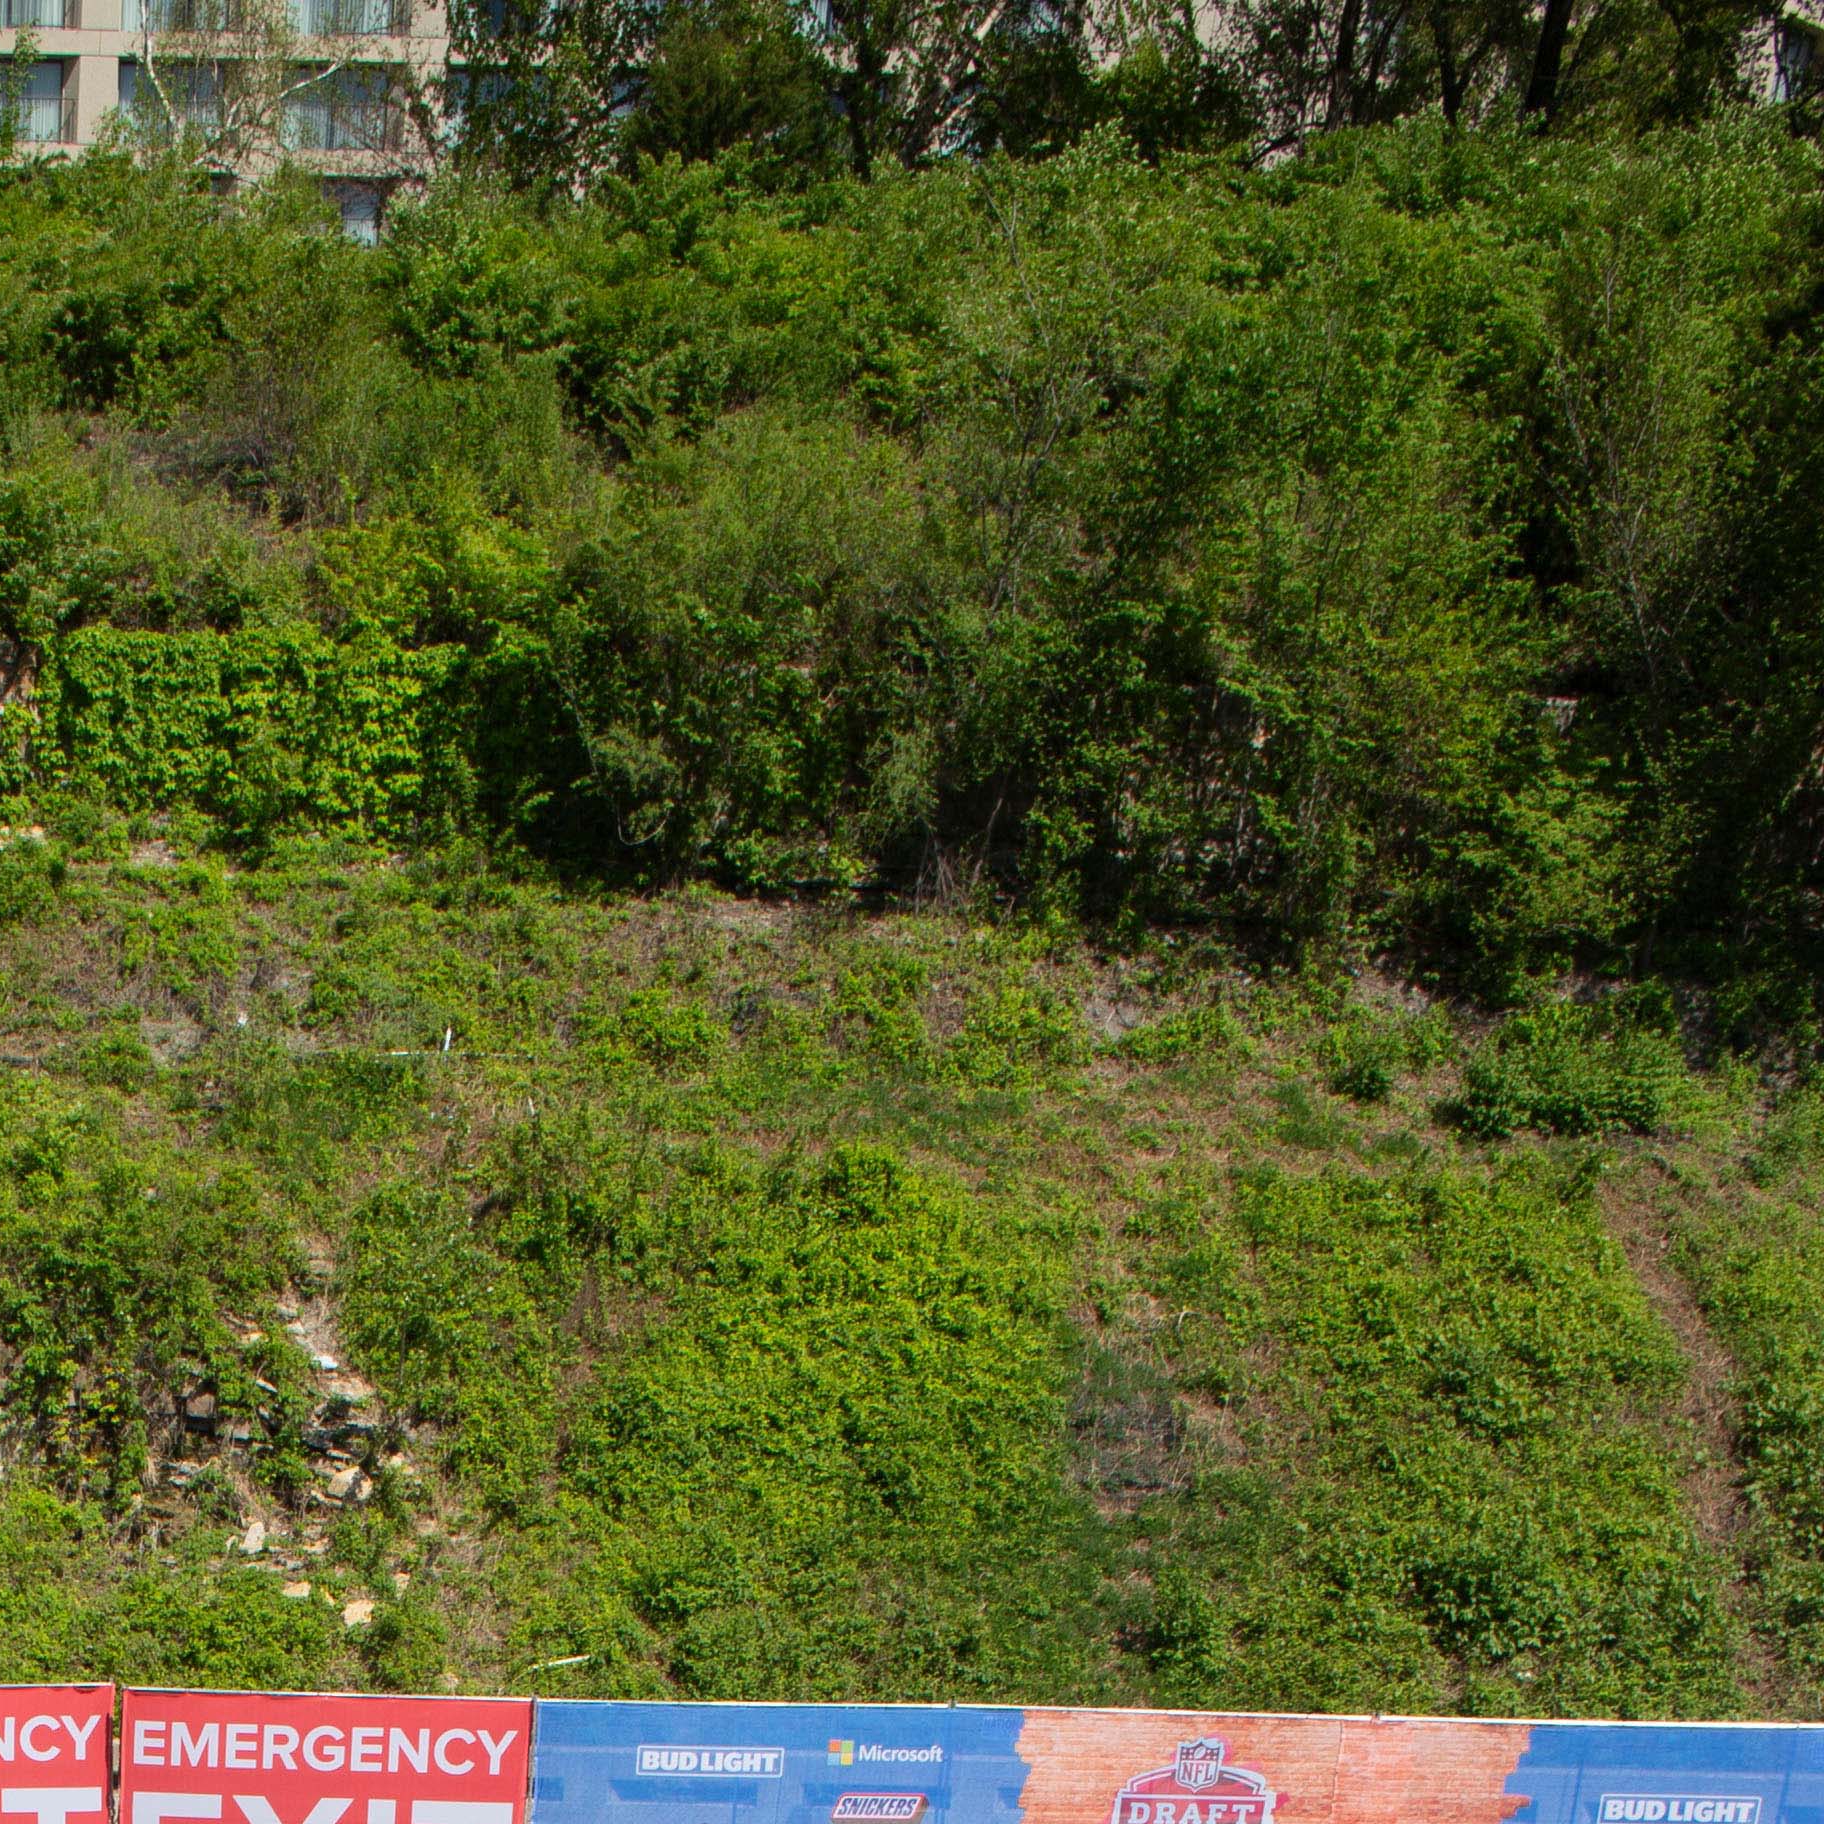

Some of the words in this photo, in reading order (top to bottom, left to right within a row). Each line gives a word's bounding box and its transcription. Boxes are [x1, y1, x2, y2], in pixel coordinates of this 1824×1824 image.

[133, 1719, 518, 1776] EMERGENCY
[858, 1744, 944, 1763] Microsoft
[642, 1752, 697, 1772] BUD
[701, 1753, 777, 1773] LIGHT
[1181, 1762, 1213, 1785] NFL
[838, 1796, 916, 1816] SNICKERS
[1604, 1799, 1666, 1822] BUD
[1667, 1800, 1756, 1824] LIGHT
